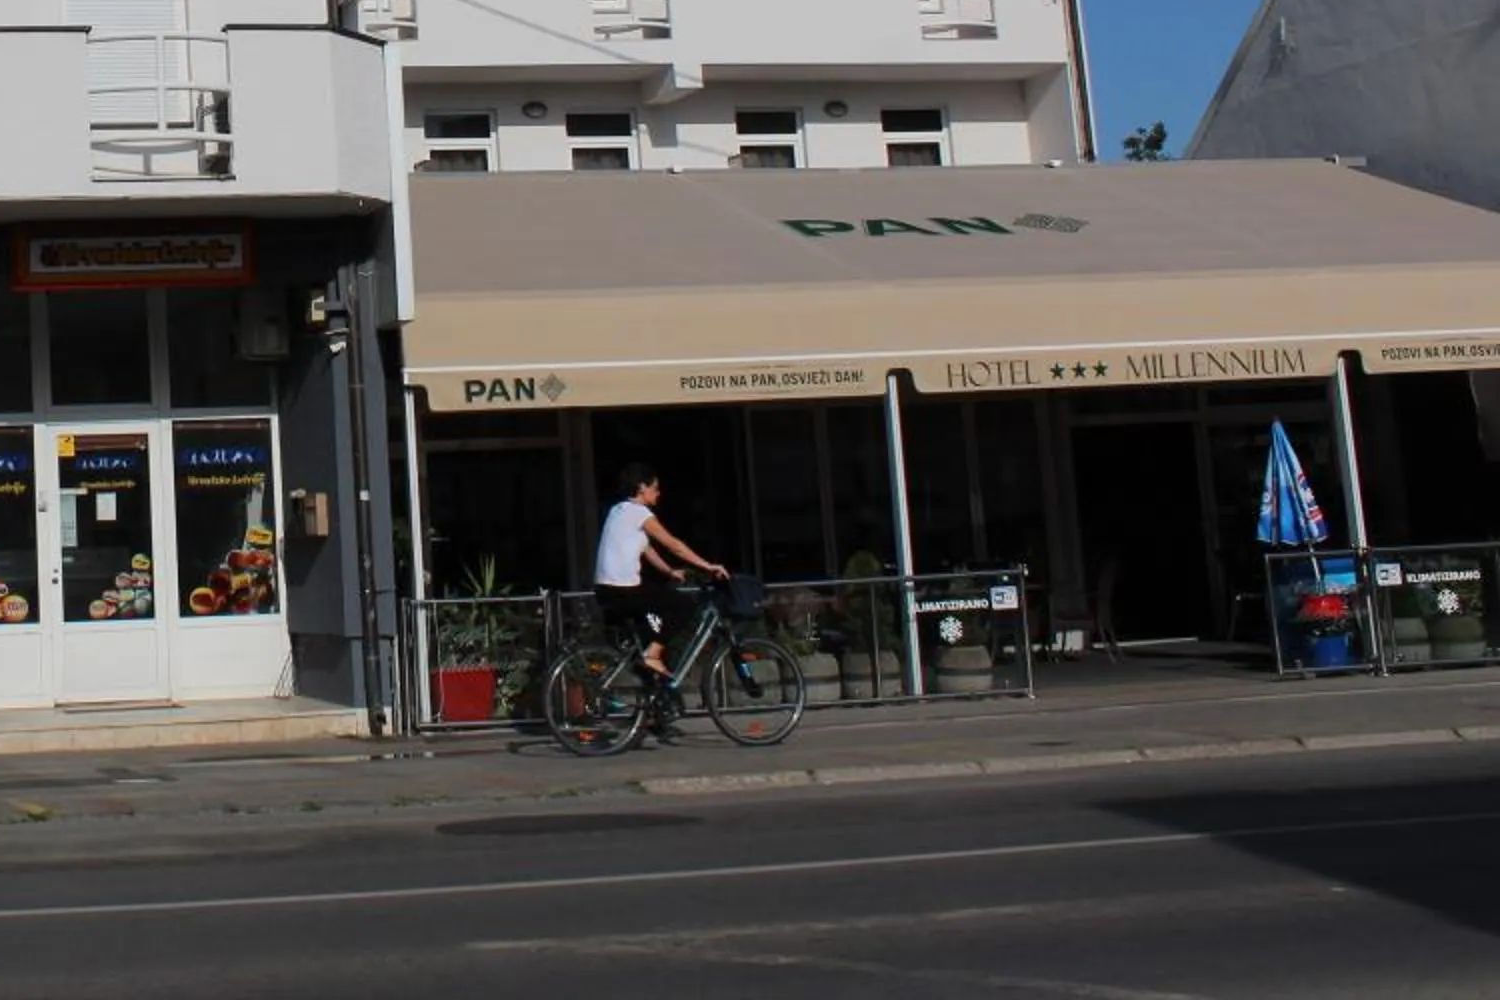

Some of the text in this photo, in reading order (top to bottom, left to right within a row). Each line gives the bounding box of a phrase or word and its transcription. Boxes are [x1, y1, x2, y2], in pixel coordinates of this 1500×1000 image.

[779, 216, 1014, 238] PAN
[1382, 347, 1421, 360] POZOVI
[1424, 346, 1440, 359] NA
[680, 375, 725, 389] POZOVI
[729, 374, 747, 387] NA
[835, 369, 865, 384] DAN!
[947, 348, 1306, 389] HOTEL MILLENNIUM
[464, 376, 535, 403] PAN
[914, 599, 989, 613] LIMATIZIRANO
